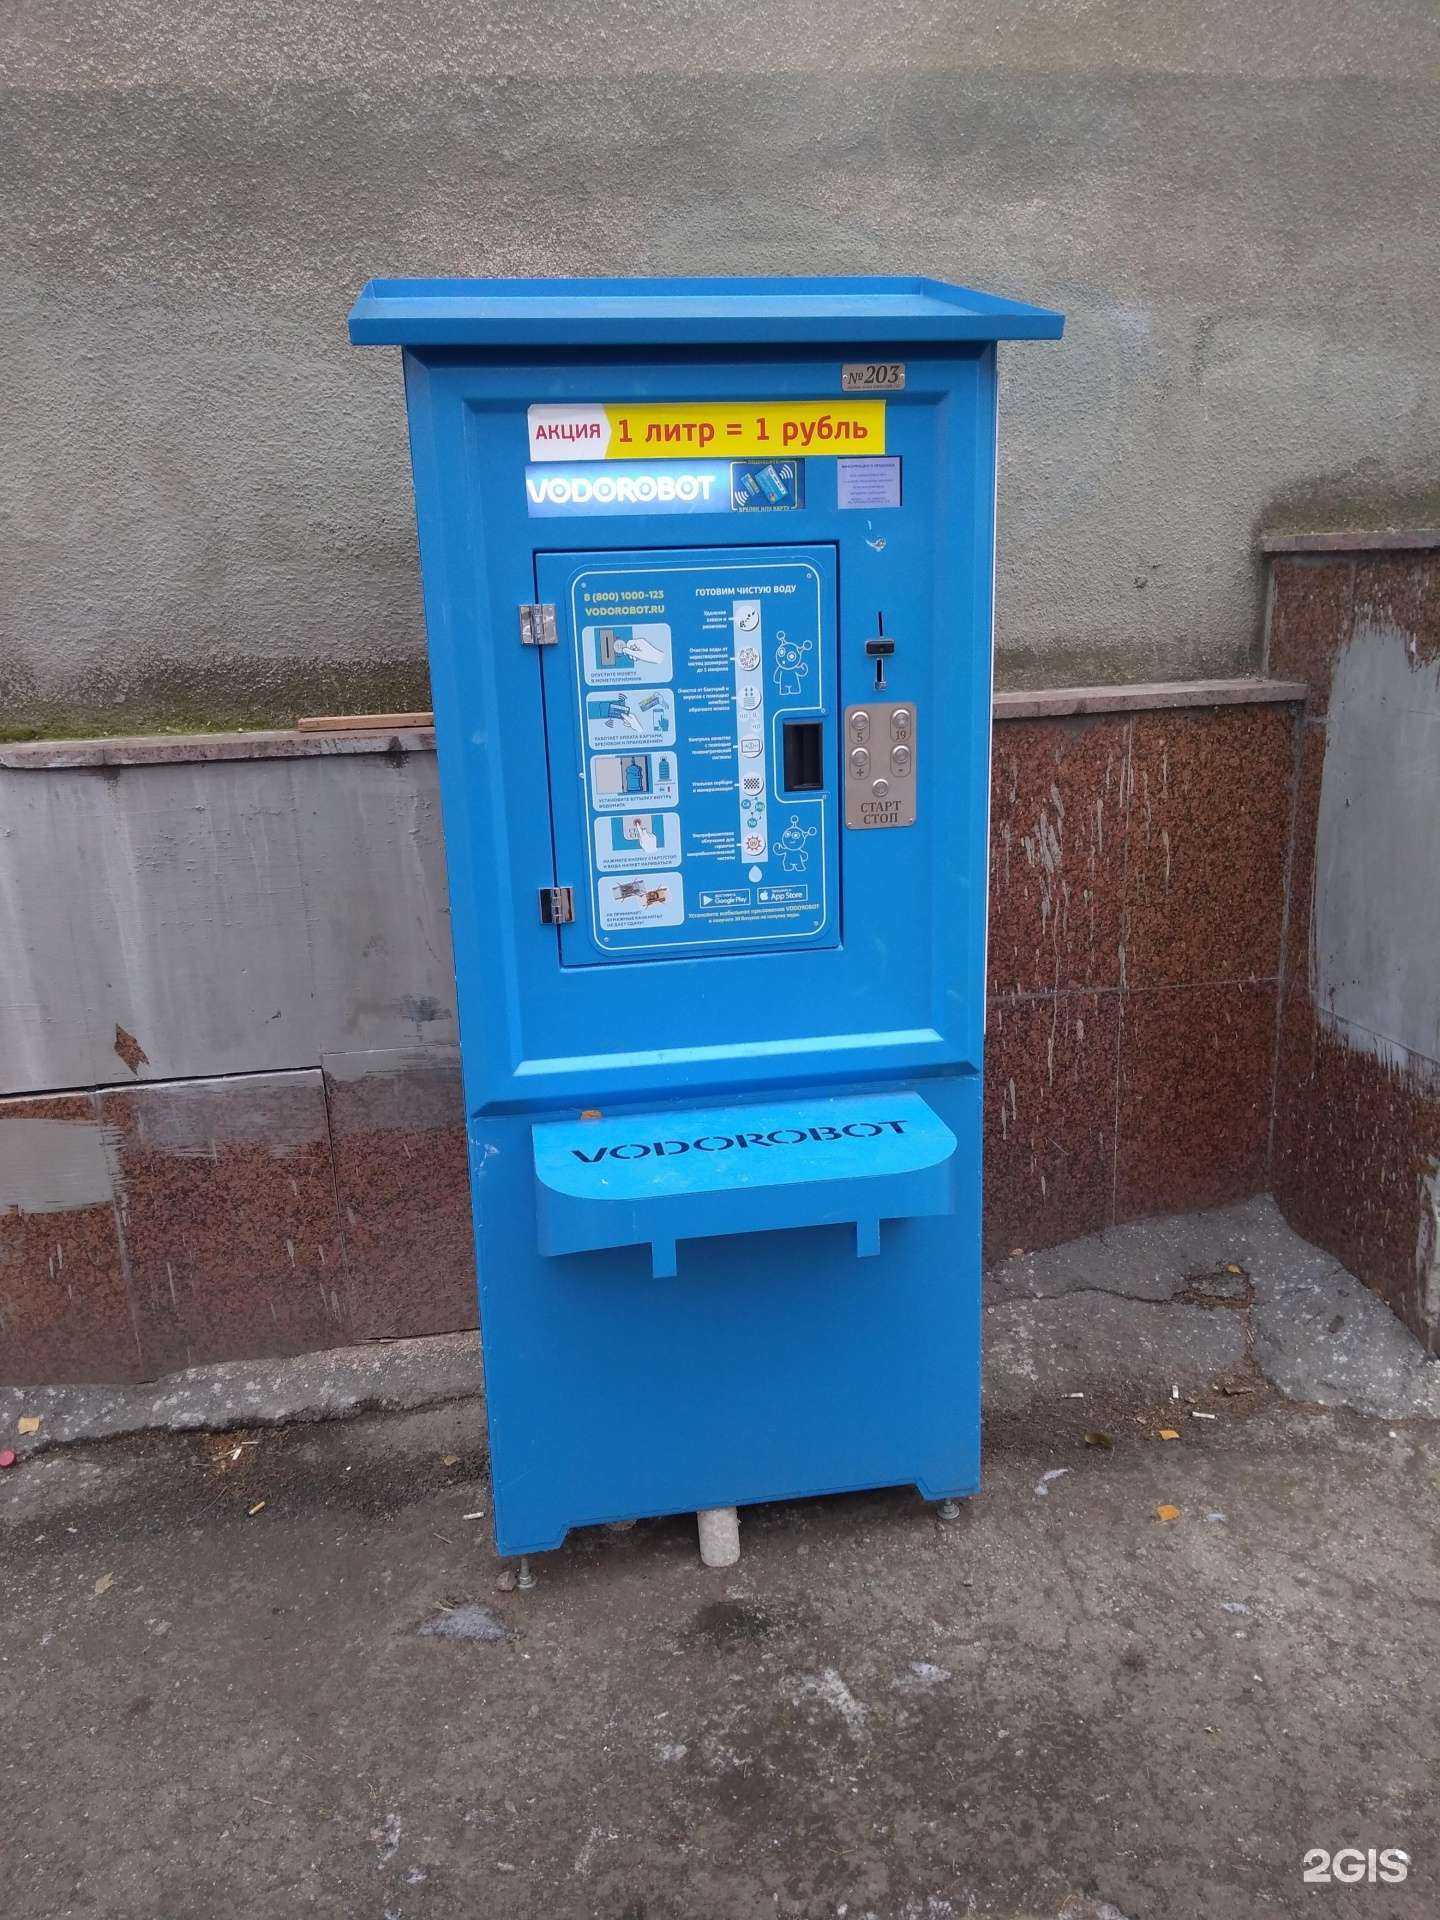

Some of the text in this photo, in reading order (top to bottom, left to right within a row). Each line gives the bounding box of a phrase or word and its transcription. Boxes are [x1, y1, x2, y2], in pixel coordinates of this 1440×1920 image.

[848, 365, 900, 384] №203
[536, 423, 601, 442] АКЦИЯ
[618, 415, 869, 448] 1 литр = 1 рубль
[526, 474, 715, 504] VODOROBOT
[695, 584, 797, 597] ГОТОВИМ ЧИСТУЮ ВОДУ
[592, 592, 619, 603] (800)
[585, 605, 665, 616] VODOROBOT.RU
[860, 799, 902, 813] СТАРТ
[863, 812, 898, 825] СТОП
[735, 896, 747, 904] Play
[771, 893, 785, 901] App
[785, 891, 803, 899] Store
[570, 1119, 910, 1164] VODOROBOT
